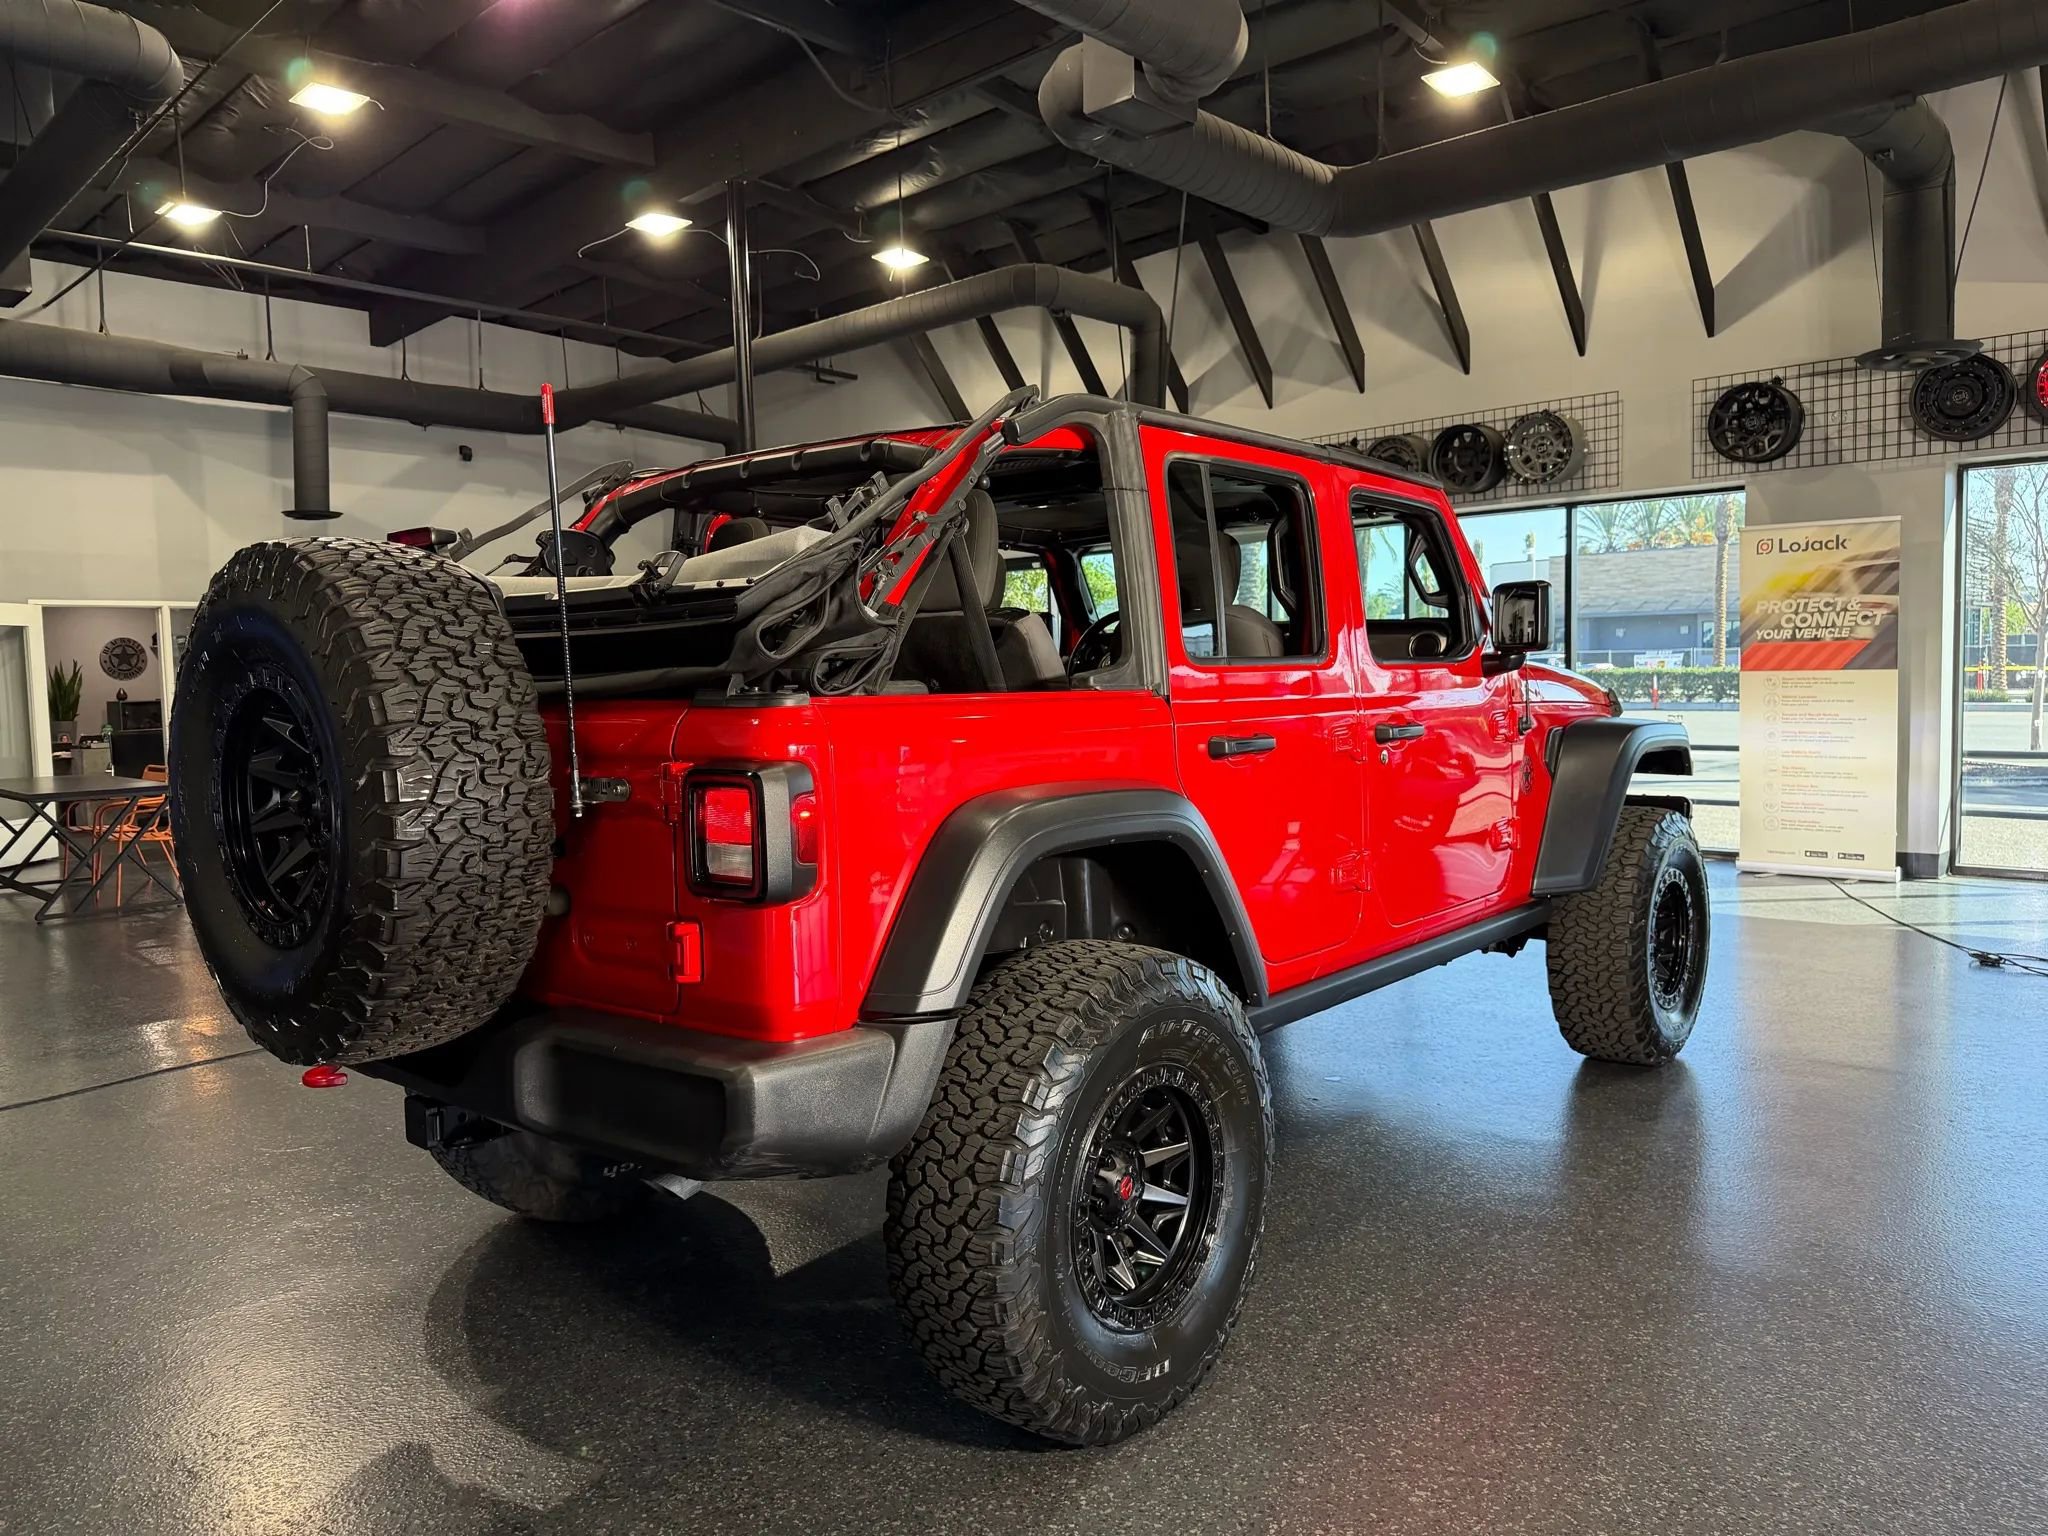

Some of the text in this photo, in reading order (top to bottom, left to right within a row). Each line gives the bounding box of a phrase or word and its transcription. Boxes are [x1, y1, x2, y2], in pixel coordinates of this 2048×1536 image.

[1755, 596, 1862, 614] PROTECT &
[1780, 610, 1886, 628] CONNECT
[1756, 627, 1851, 640] YOUR VEHICLE
